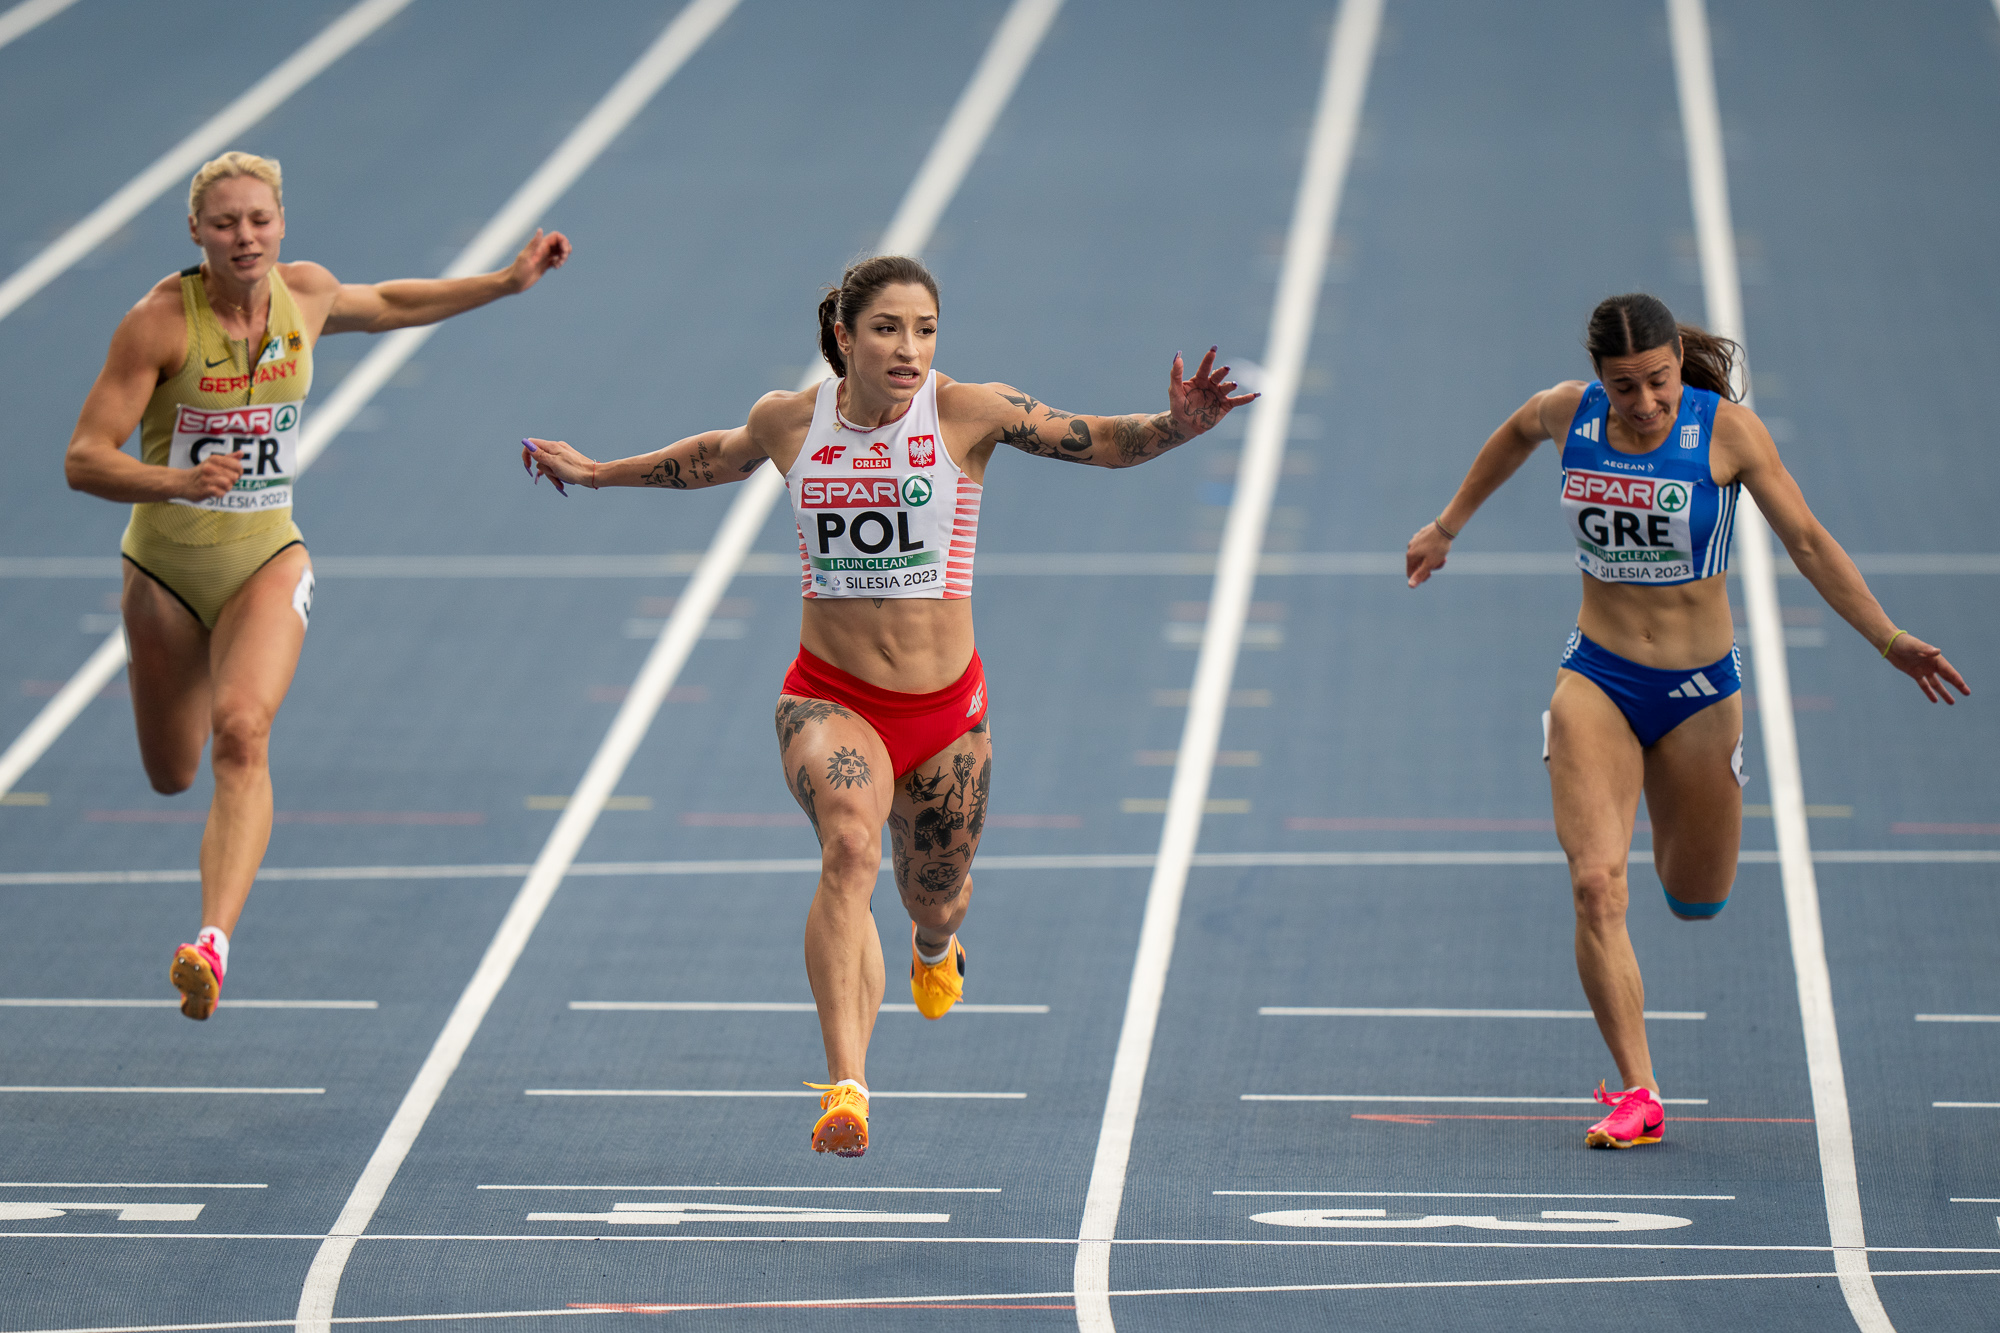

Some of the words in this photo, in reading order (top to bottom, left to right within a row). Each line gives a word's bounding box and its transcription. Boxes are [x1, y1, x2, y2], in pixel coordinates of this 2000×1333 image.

[199, 359, 298, 393] GERMANY
[181, 410, 271, 432] SPAR
[190, 437, 282, 475] GER
[811, 445, 847, 465] 4F
[855, 459, 889, 468] ORLEN
[1603, 459, 1646, 471] AEGEAN
[261, 491, 288, 506] 2023
[803, 481, 898, 504] SPAR
[1567, 474, 1652, 506] SPAR
[816, 511, 924, 554] POL
[1578, 507, 1674, 547] GRE
[830, 559, 834, 570] I
[836, 558, 864, 570] RUN
[1600, 565, 1652, 579] SILESIA
[1654, 564, 1690, 578] 2023
[846, 575, 900, 589] SILESIA
[903, 569, 938, 586] 2023
[1249, 1209, 1693, 1232] 3
